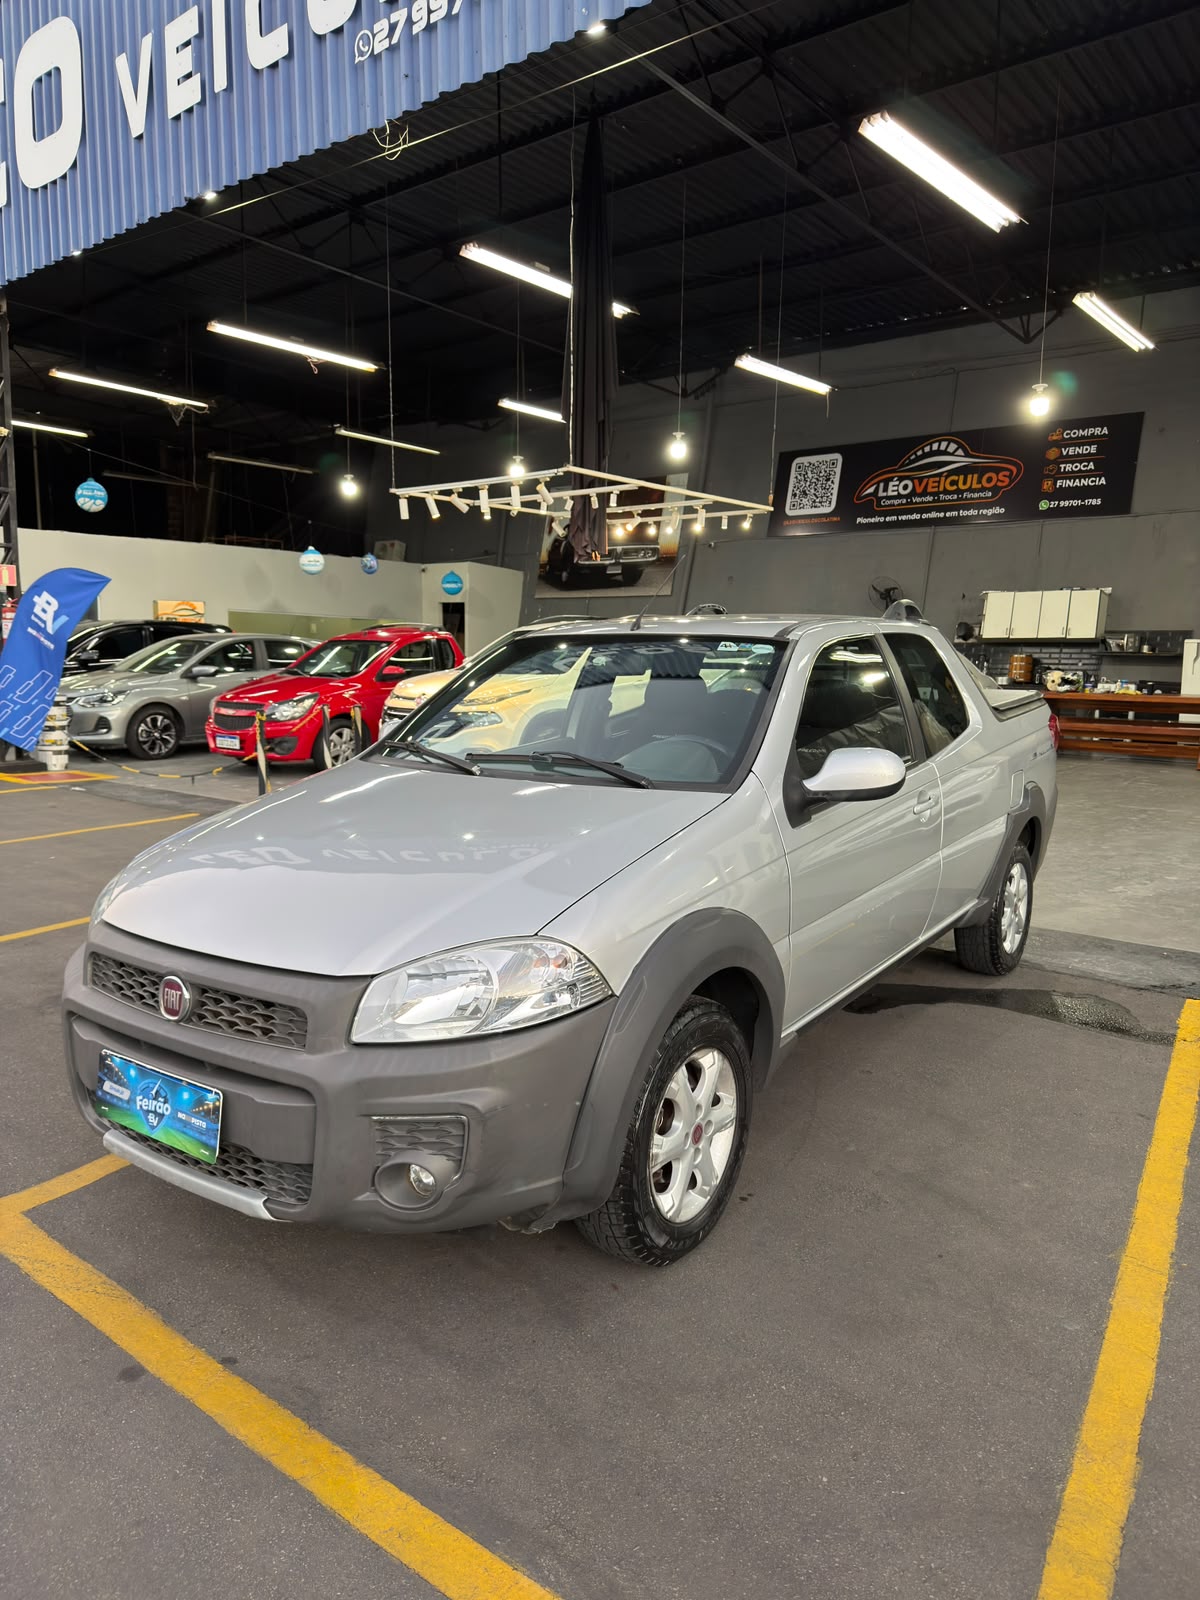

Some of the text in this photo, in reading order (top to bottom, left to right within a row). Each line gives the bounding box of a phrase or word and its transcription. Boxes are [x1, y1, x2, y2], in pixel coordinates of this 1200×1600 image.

[373, 8, 408, 56] 27
[0, 0, 391, 208] O VEIC
[1063, 427, 1108, 438] COMPRA
[1061, 445, 1098, 456] VENDE
[1059, 462, 1095, 472] TROCA
[1056, 477, 1106, 488] FINANCIA
[880, 490, 992, 506] Compra Vende Troca Financia
[856, 515, 885, 524] Pioneiro
[898, 513, 921, 521] venda
[921, 511, 945, 519] online
[979, 506, 1006, 516] região
[164, 987, 182, 1011] FIAT
[136, 1095, 172, 1116] Feirão
